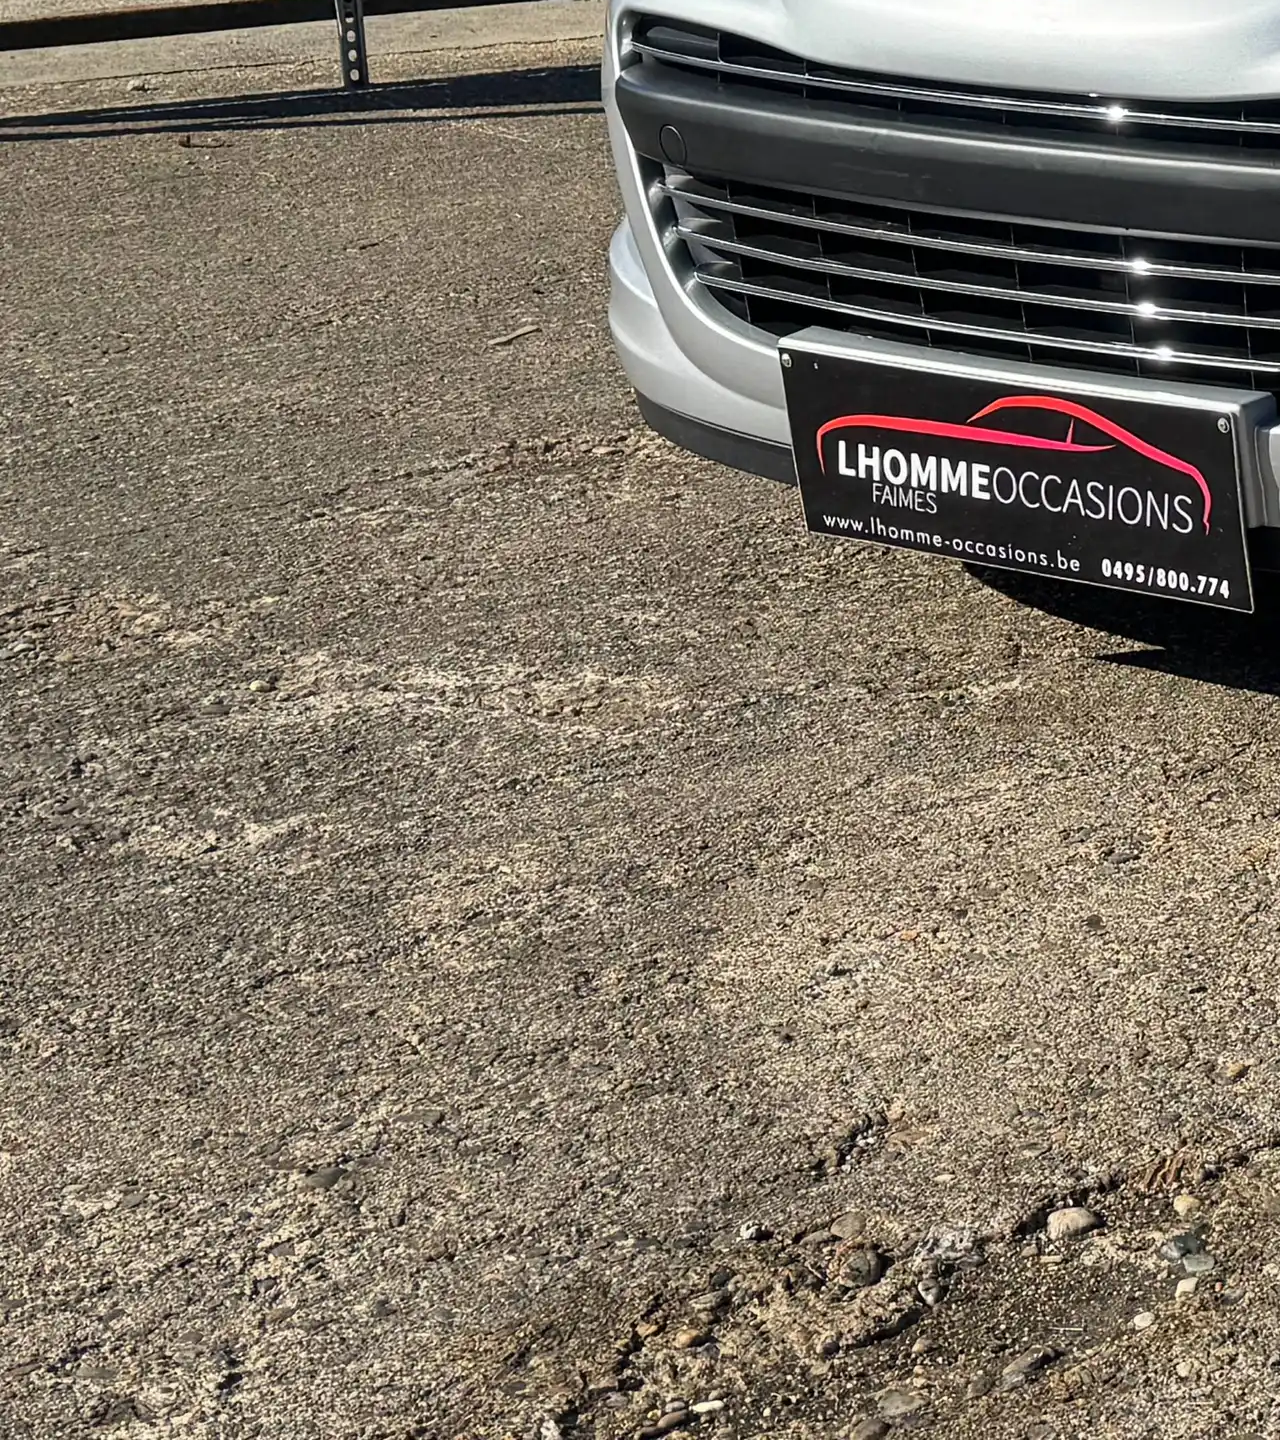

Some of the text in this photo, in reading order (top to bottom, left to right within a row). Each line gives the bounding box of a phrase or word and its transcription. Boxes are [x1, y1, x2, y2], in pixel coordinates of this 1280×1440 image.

[838, 440, 1194, 534] LHOMMEOCCASIONS
[872, 482, 938, 514] FAIMES
[822, 514, 1230, 599] www.lhomme-occasions.be 0495/800.774
